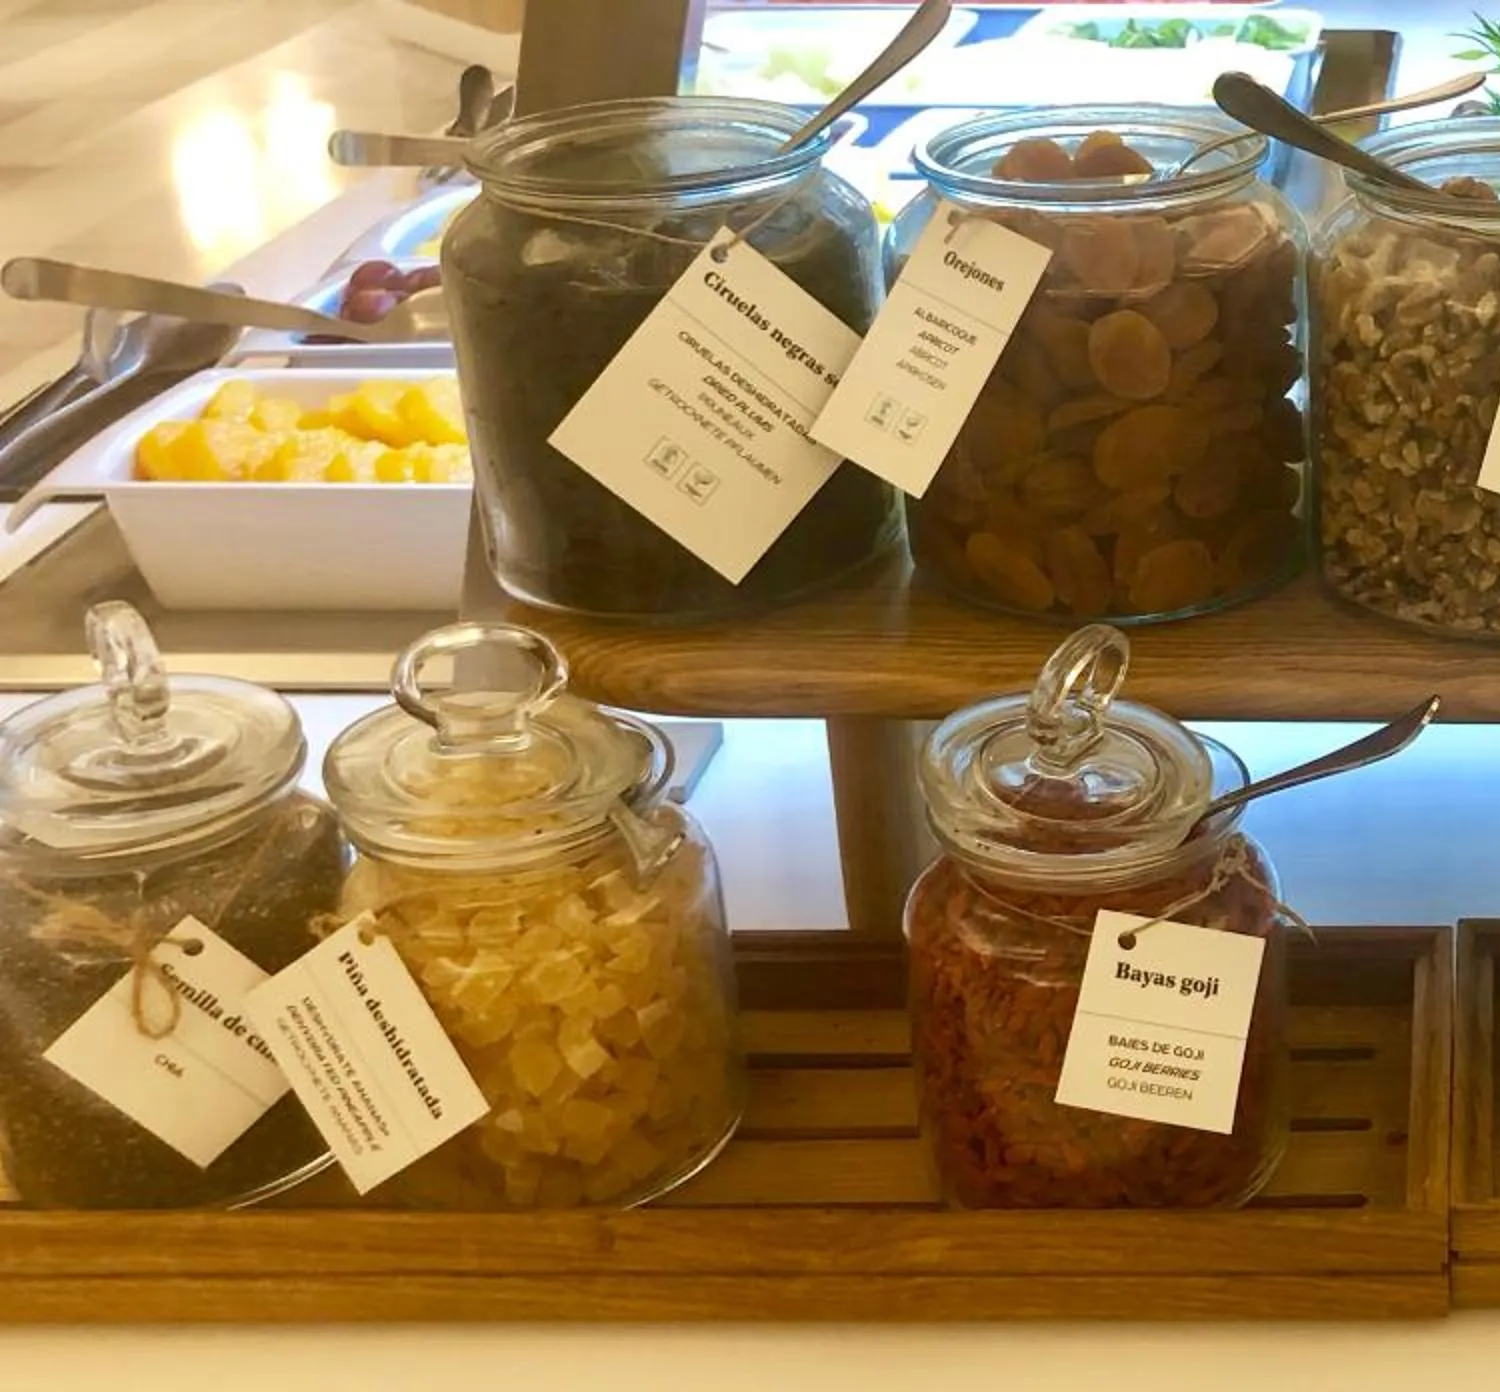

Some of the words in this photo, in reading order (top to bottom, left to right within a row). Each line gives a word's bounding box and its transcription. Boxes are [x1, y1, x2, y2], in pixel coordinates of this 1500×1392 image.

[943, 250, 1005, 292] Orejones
[703, 271, 771, 331] Ciruelas
[769, 328, 826, 376] negras
[917, 330, 961, 355] APRICOT
[678, 330, 731, 376] CIRUELAS
[701, 375, 738, 403] DRIED
[734, 400, 775, 433] PLUMS
[1115, 961, 1176, 989] Bayas
[1179, 976, 1220, 999] goji
[222, 1015, 248, 1037] de
[337, 951, 369, 997] Piña
[365, 998, 443, 1120] deshidratada
[1108, 1034, 1150, 1052] BAIES
[1151, 1041, 1171, 1055] DE
[1172, 1045, 1205, 1061] GOJI
[1108, 1056, 1143, 1071] GOJI
[1141, 1061, 1201, 1081] BERRIES
[1107, 1076, 1138, 1092] GOJI
[1139, 1081, 1193, 1101] BEEREN
